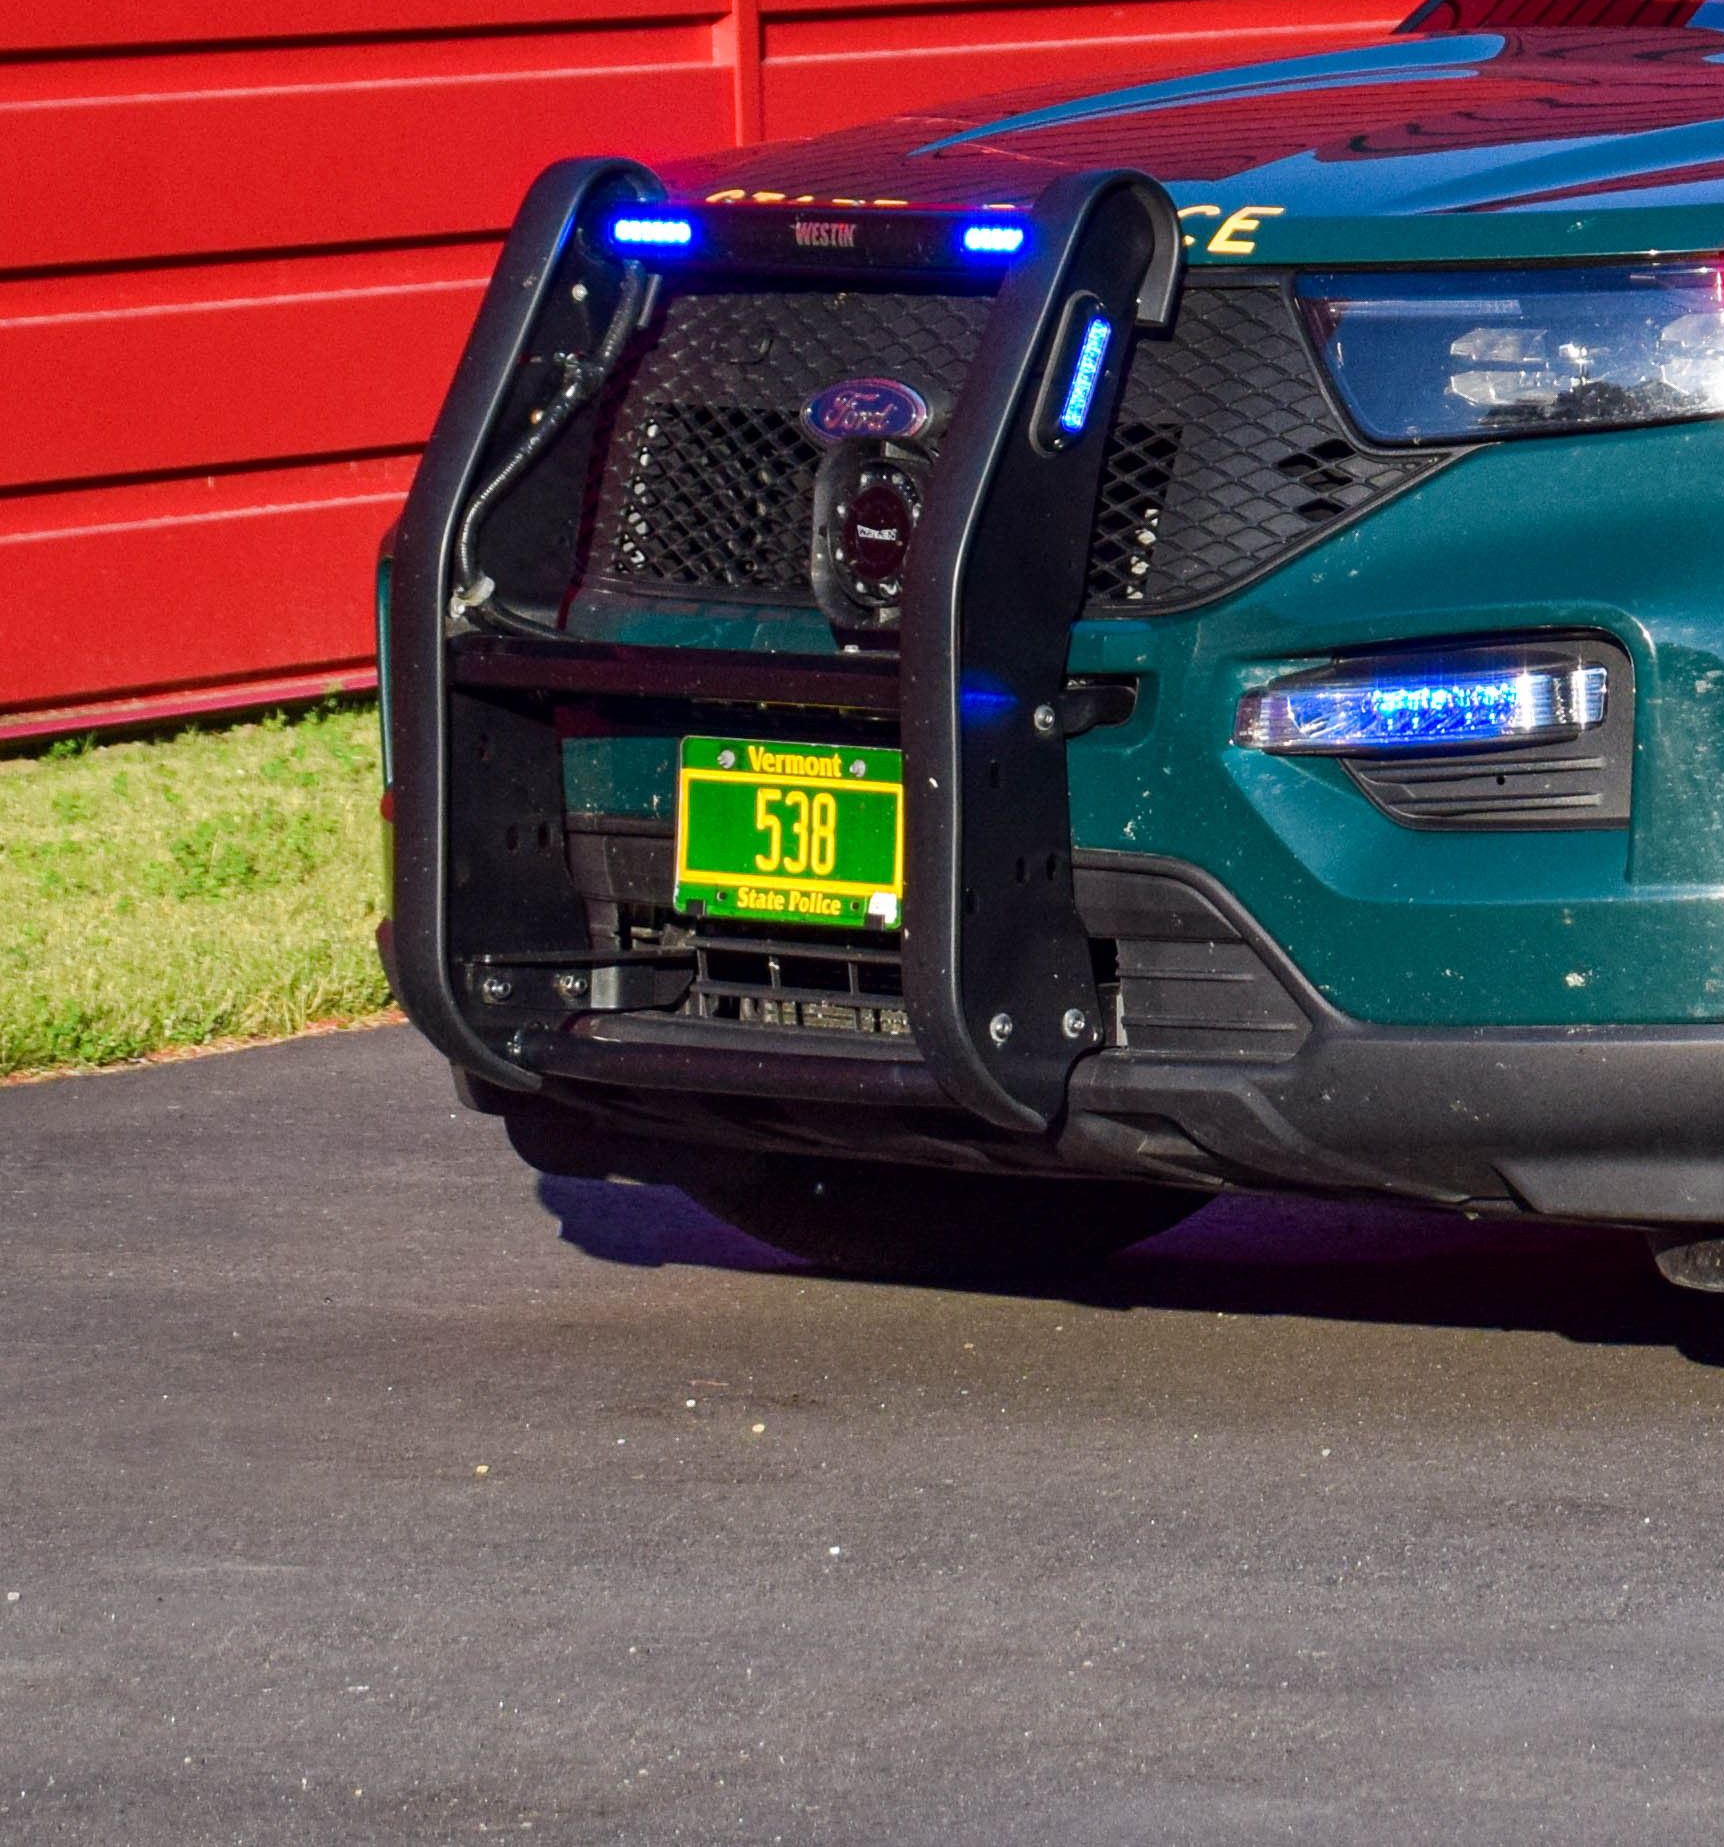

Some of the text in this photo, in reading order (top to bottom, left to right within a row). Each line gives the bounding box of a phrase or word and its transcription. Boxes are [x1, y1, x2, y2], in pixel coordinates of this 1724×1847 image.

[824, 391, 898, 430] Ford
[747, 745, 842, 777] Vermont
[755, 788, 836, 876] 538
[737, 887, 842, 916] State Police
